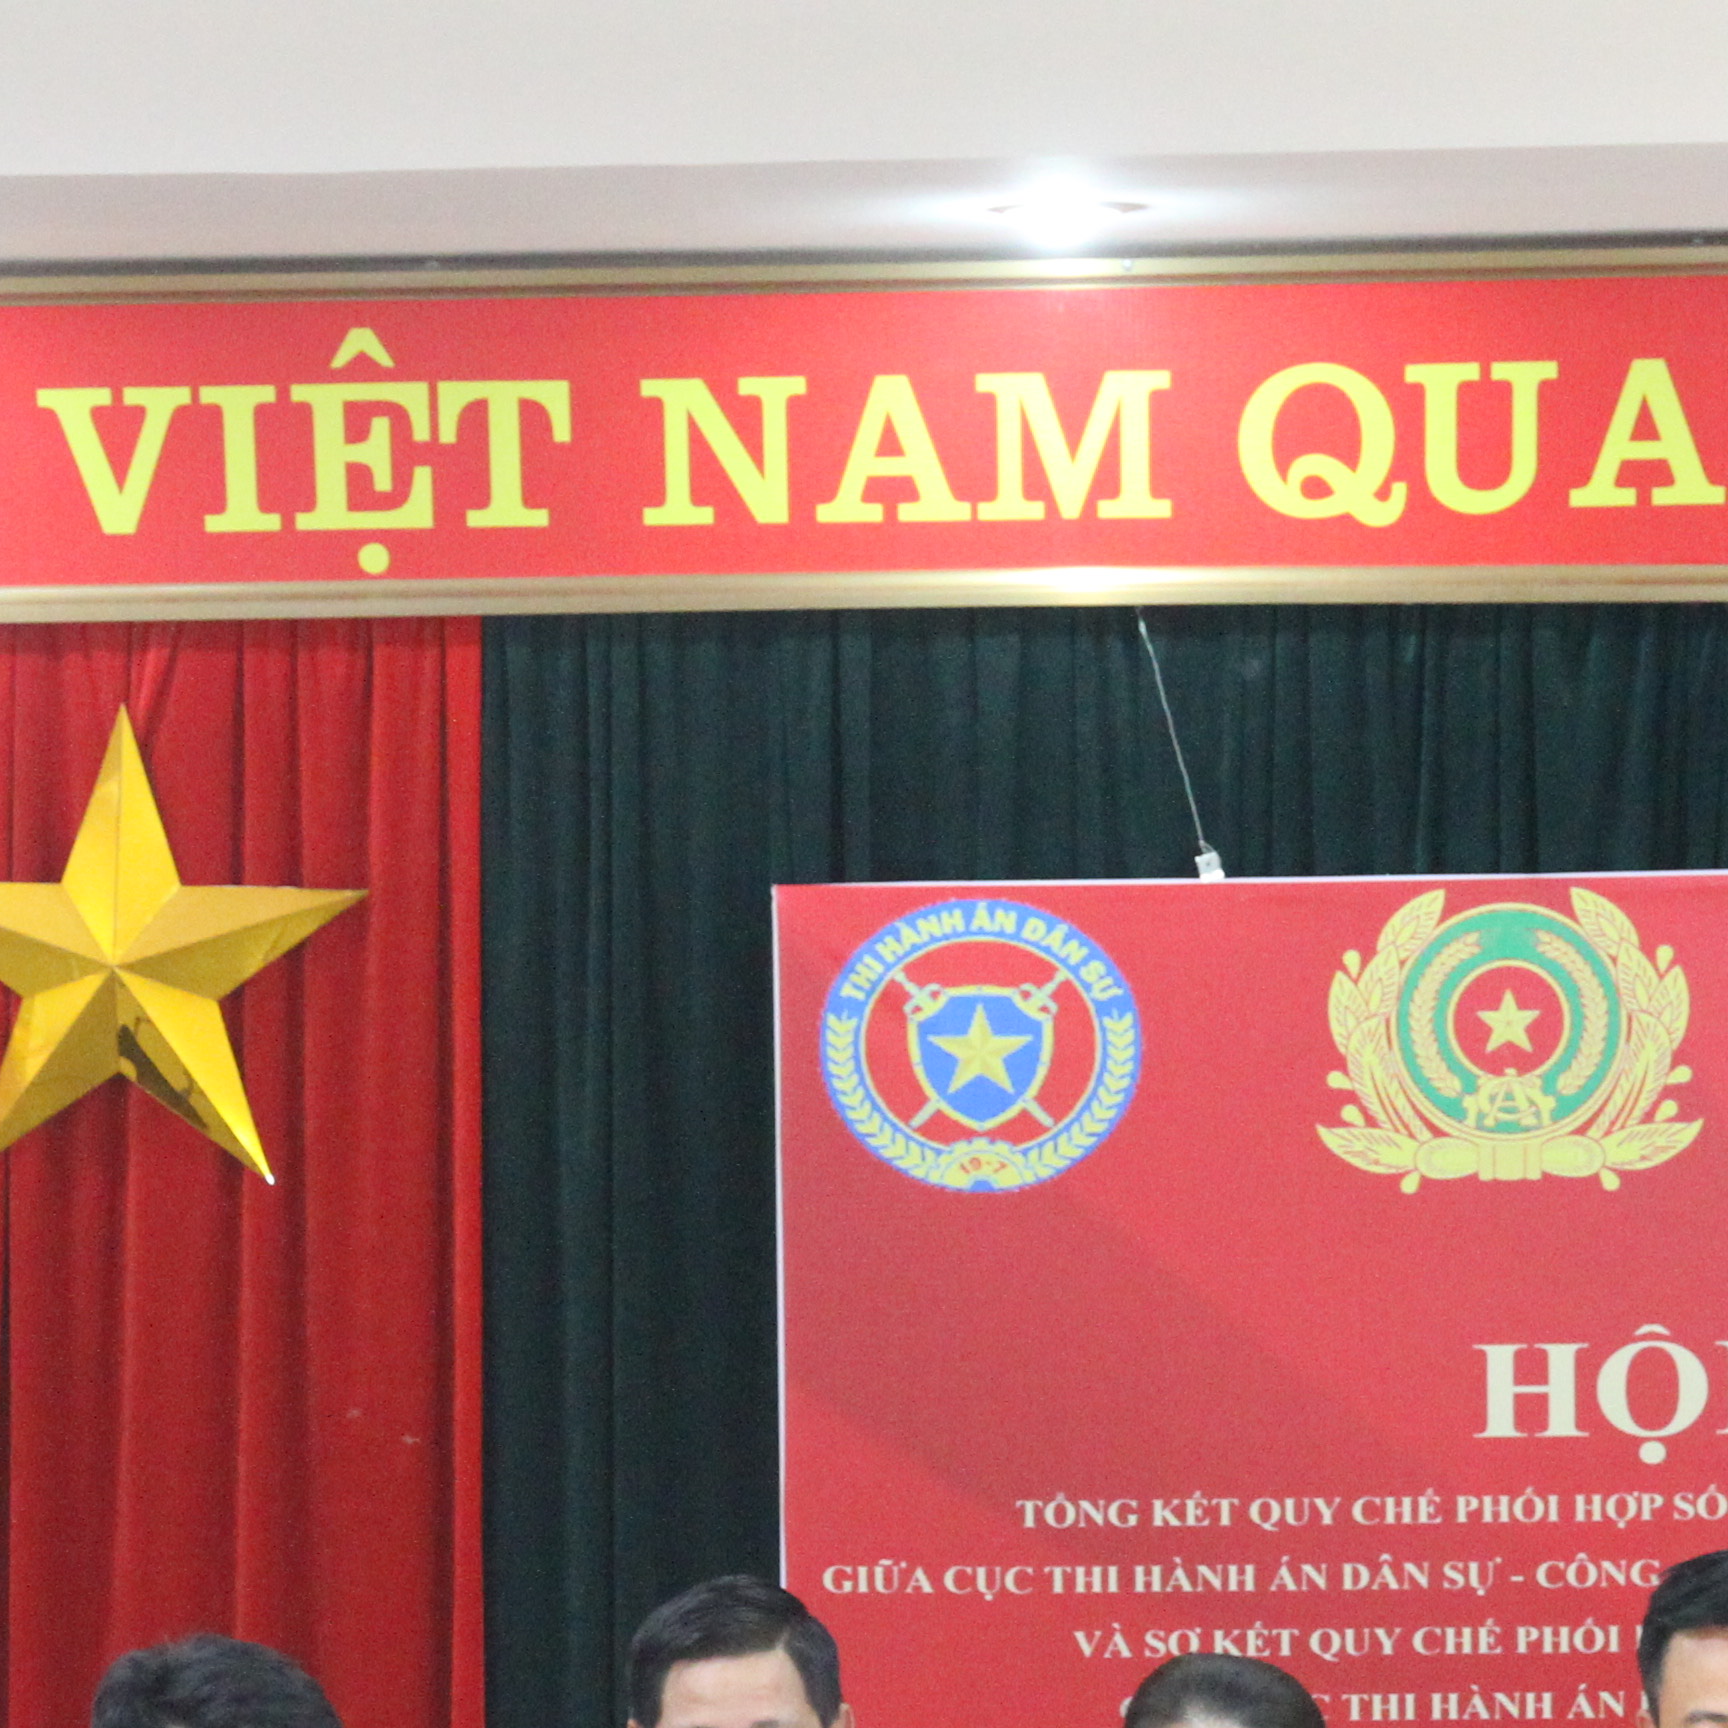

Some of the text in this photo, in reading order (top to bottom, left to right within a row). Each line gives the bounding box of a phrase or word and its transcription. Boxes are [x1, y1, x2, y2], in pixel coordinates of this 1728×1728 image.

[36, 326, 572, 576] VIỆT
[640, 370, 1173, 527] NAM
[839, 902, 1125, 1002] THI HÀNH ÁN DÂN SỰ
[1016, 1493, 1138, 1528] TỔNG
[1153, 1491, 1238, 1526] KẾT
[1249, 1498, 1340, 1531] QUY
[1352, 1489, 1442, 1524] CHẾ
[1457, 1487, 1558, 1522] PHỐI
[1576, 1492, 1664, 1528] HỢP
[1674, 1485, 1728, 1519] SỐ
[823, 1559, 933, 1593] GIỮA
[944, 1566, 1033, 1600] CỤC
[1044, 1566, 1118, 1593] THI
[1135, 1557, 1254, 1592] HÀNH
[1270, 1556, 1326, 1591] ÁN
[1343, 1554, 1428, 1590] DÂN
[1443, 1557, 1501, 1595] SỰ
[1536, 1553, 1659, 1588] CÔNG
[1074, 1623, 1132, 1658] VÀ
[1214, 1621, 1299, 1656] KẾT
[1309, 1628, 1401, 1661] QUY
[1413, 1619, 1501, 1654] CHẾ
[1516, 1618, 1619, 1654] PHỐI
[1342, 1694, 1415, 1720] THI
[1432, 1685, 1552, 1720] HÀNH
[1568, 1684, 1624, 1719] ÁN
